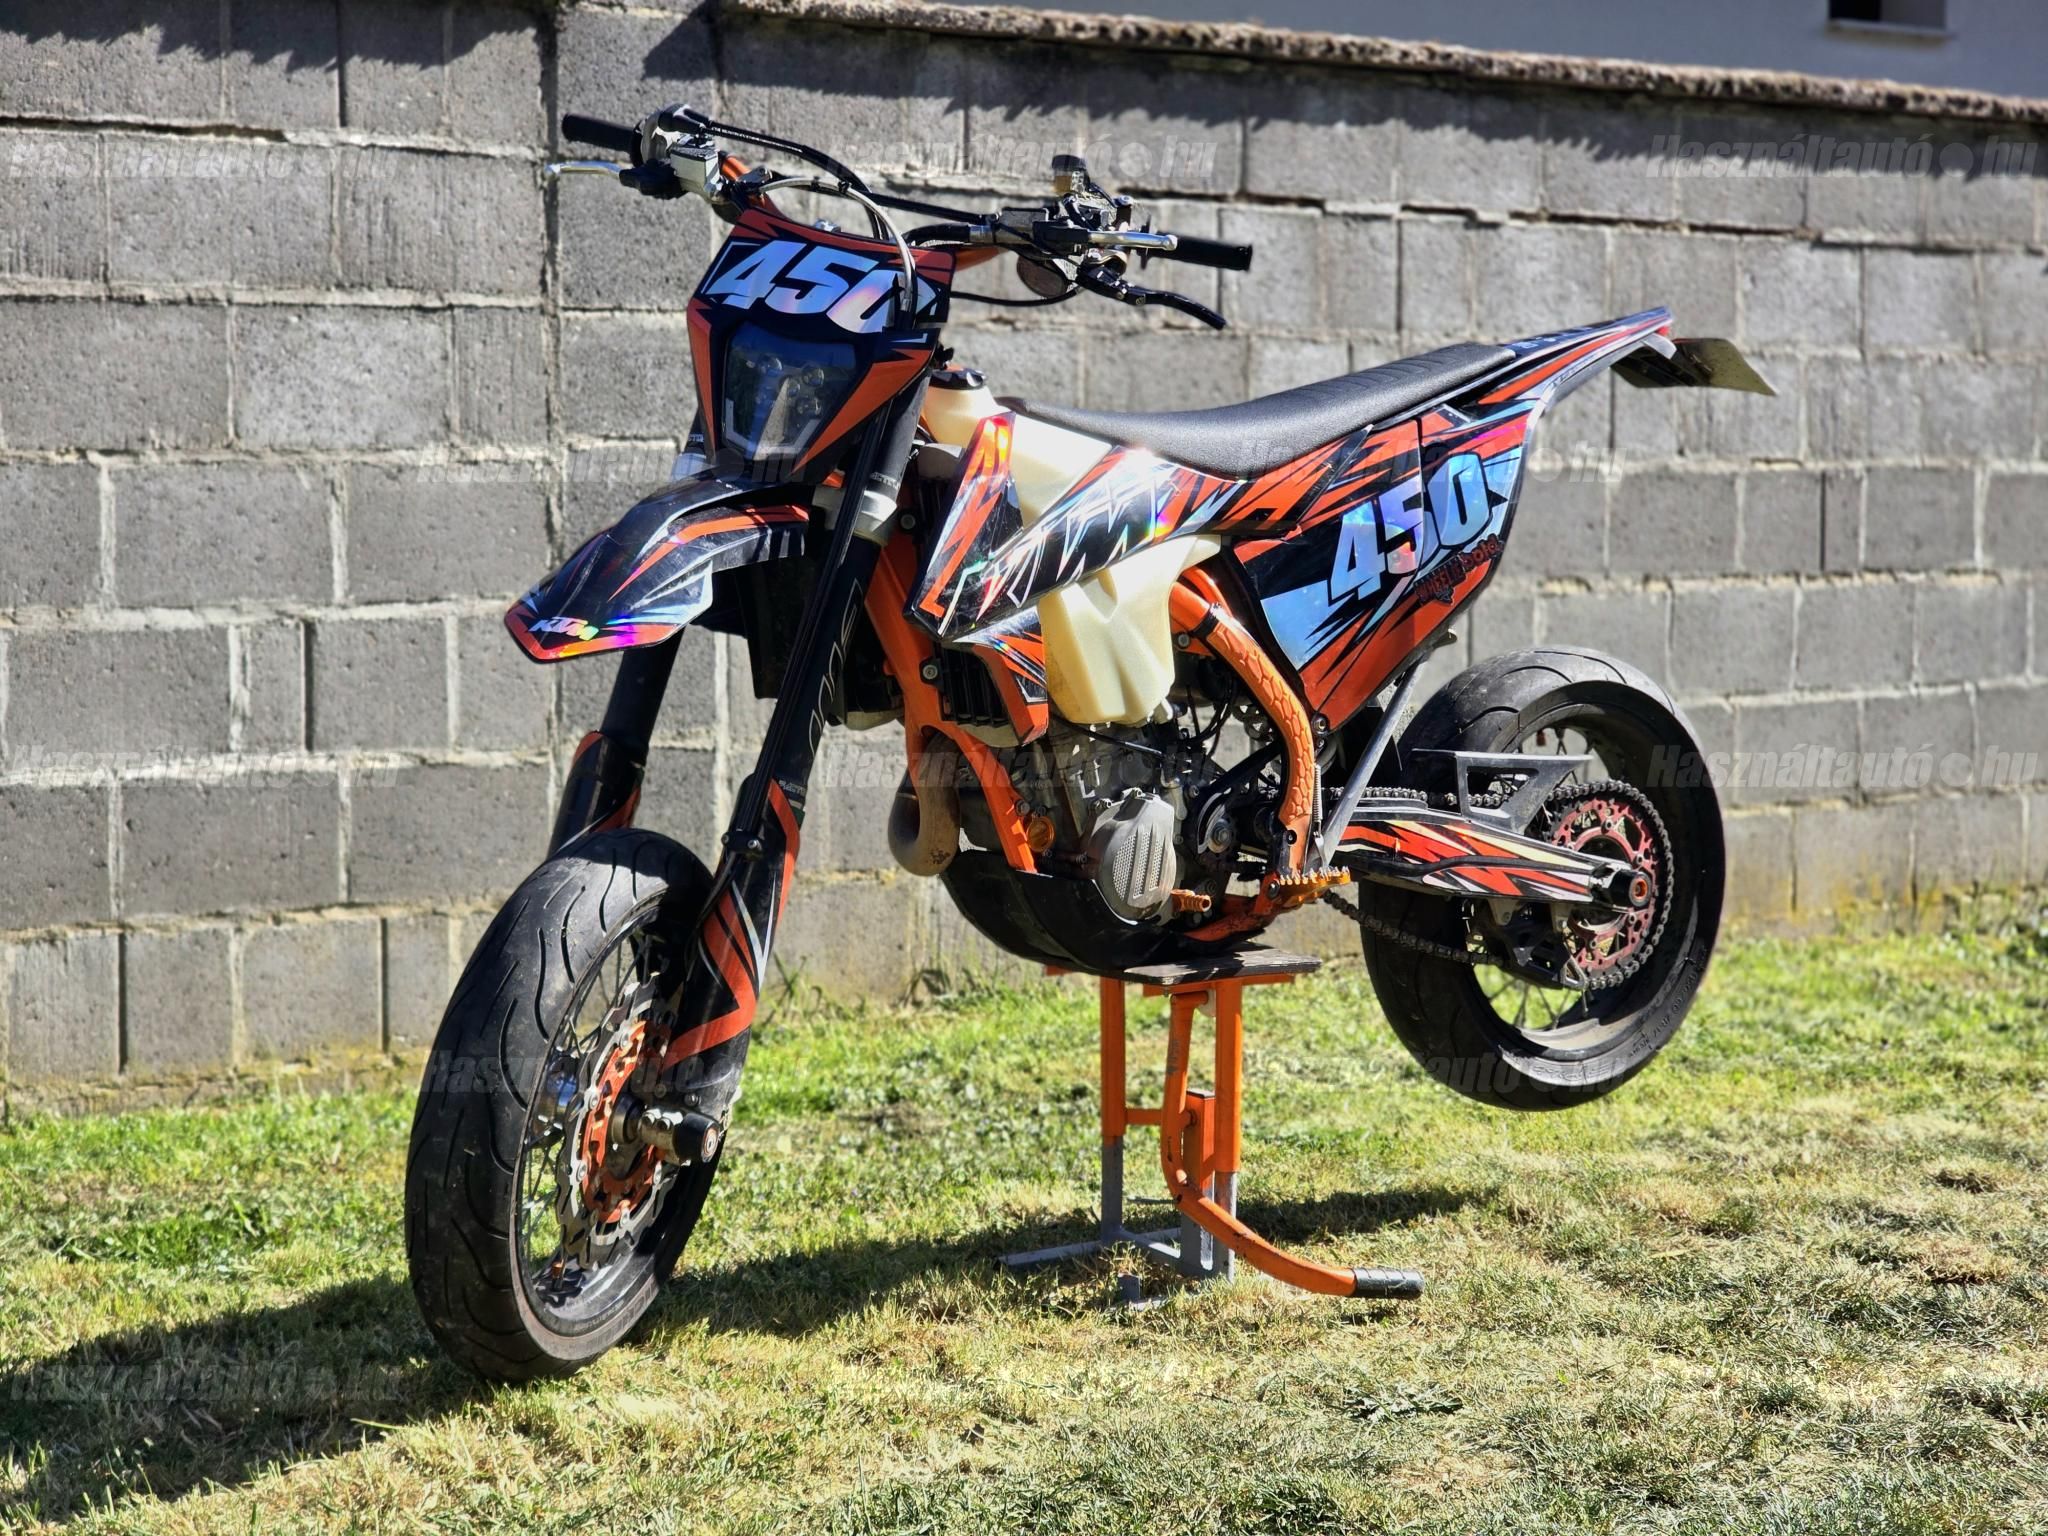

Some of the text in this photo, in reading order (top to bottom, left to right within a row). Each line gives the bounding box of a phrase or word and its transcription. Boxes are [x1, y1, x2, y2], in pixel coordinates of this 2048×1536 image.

[705, 239, 937, 334] 450
[1330, 453, 1490, 601] 450
[527, 616, 600, 641] KTM
